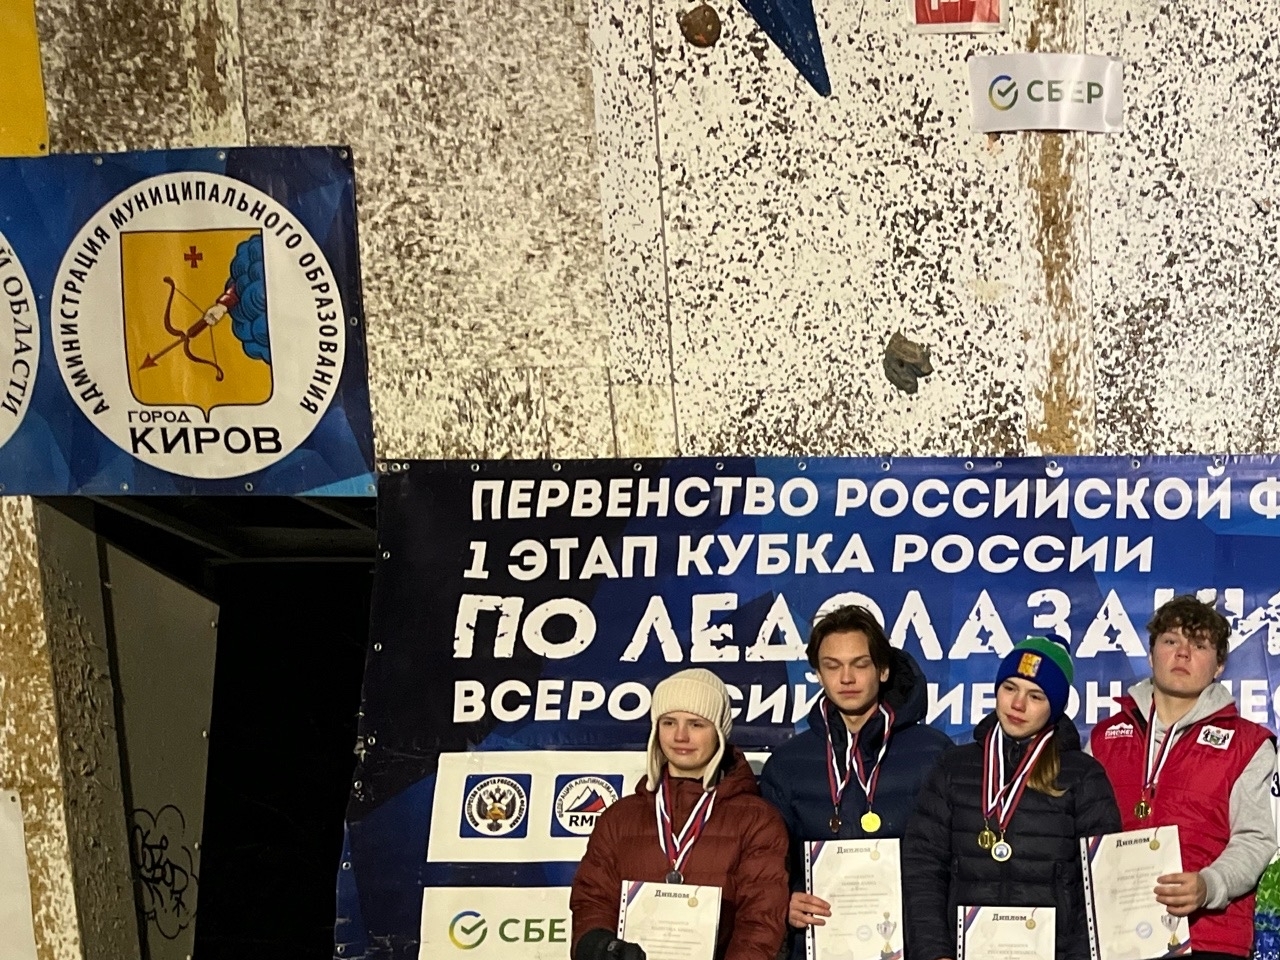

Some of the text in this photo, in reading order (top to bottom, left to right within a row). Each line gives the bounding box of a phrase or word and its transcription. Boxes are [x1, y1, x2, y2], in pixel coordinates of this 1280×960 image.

[1026, 79, 1104, 104] СБЕР
[61, 181, 339, 416] АДМИНИСТРАЦИЯ МУНИЦИПАЛЬНОГО ОБРАЗОВАНИЯ
[2, 275, 33, 418] ОБЛАСТИ
[127, 410, 192, 424] ГОРОД
[131, 426, 283, 455] КИРОВ
[472, 476, 819, 521] ПЕРВЕНСТВО
[834, 464, 1231, 520] РОССИЙСКОЙ
[463, 533, 1153, 581] 1 ЭТАП КУБКА РОССИИ
[453, 593, 597, 659] ПО
[836, 846, 871, 854] Диплом
[1115, 837, 1150, 848] Диплом
[655, 889, 690, 899] Диплом
[991, 913, 1027, 921] Диплом
[498, 918, 568, 943] СБЕ
